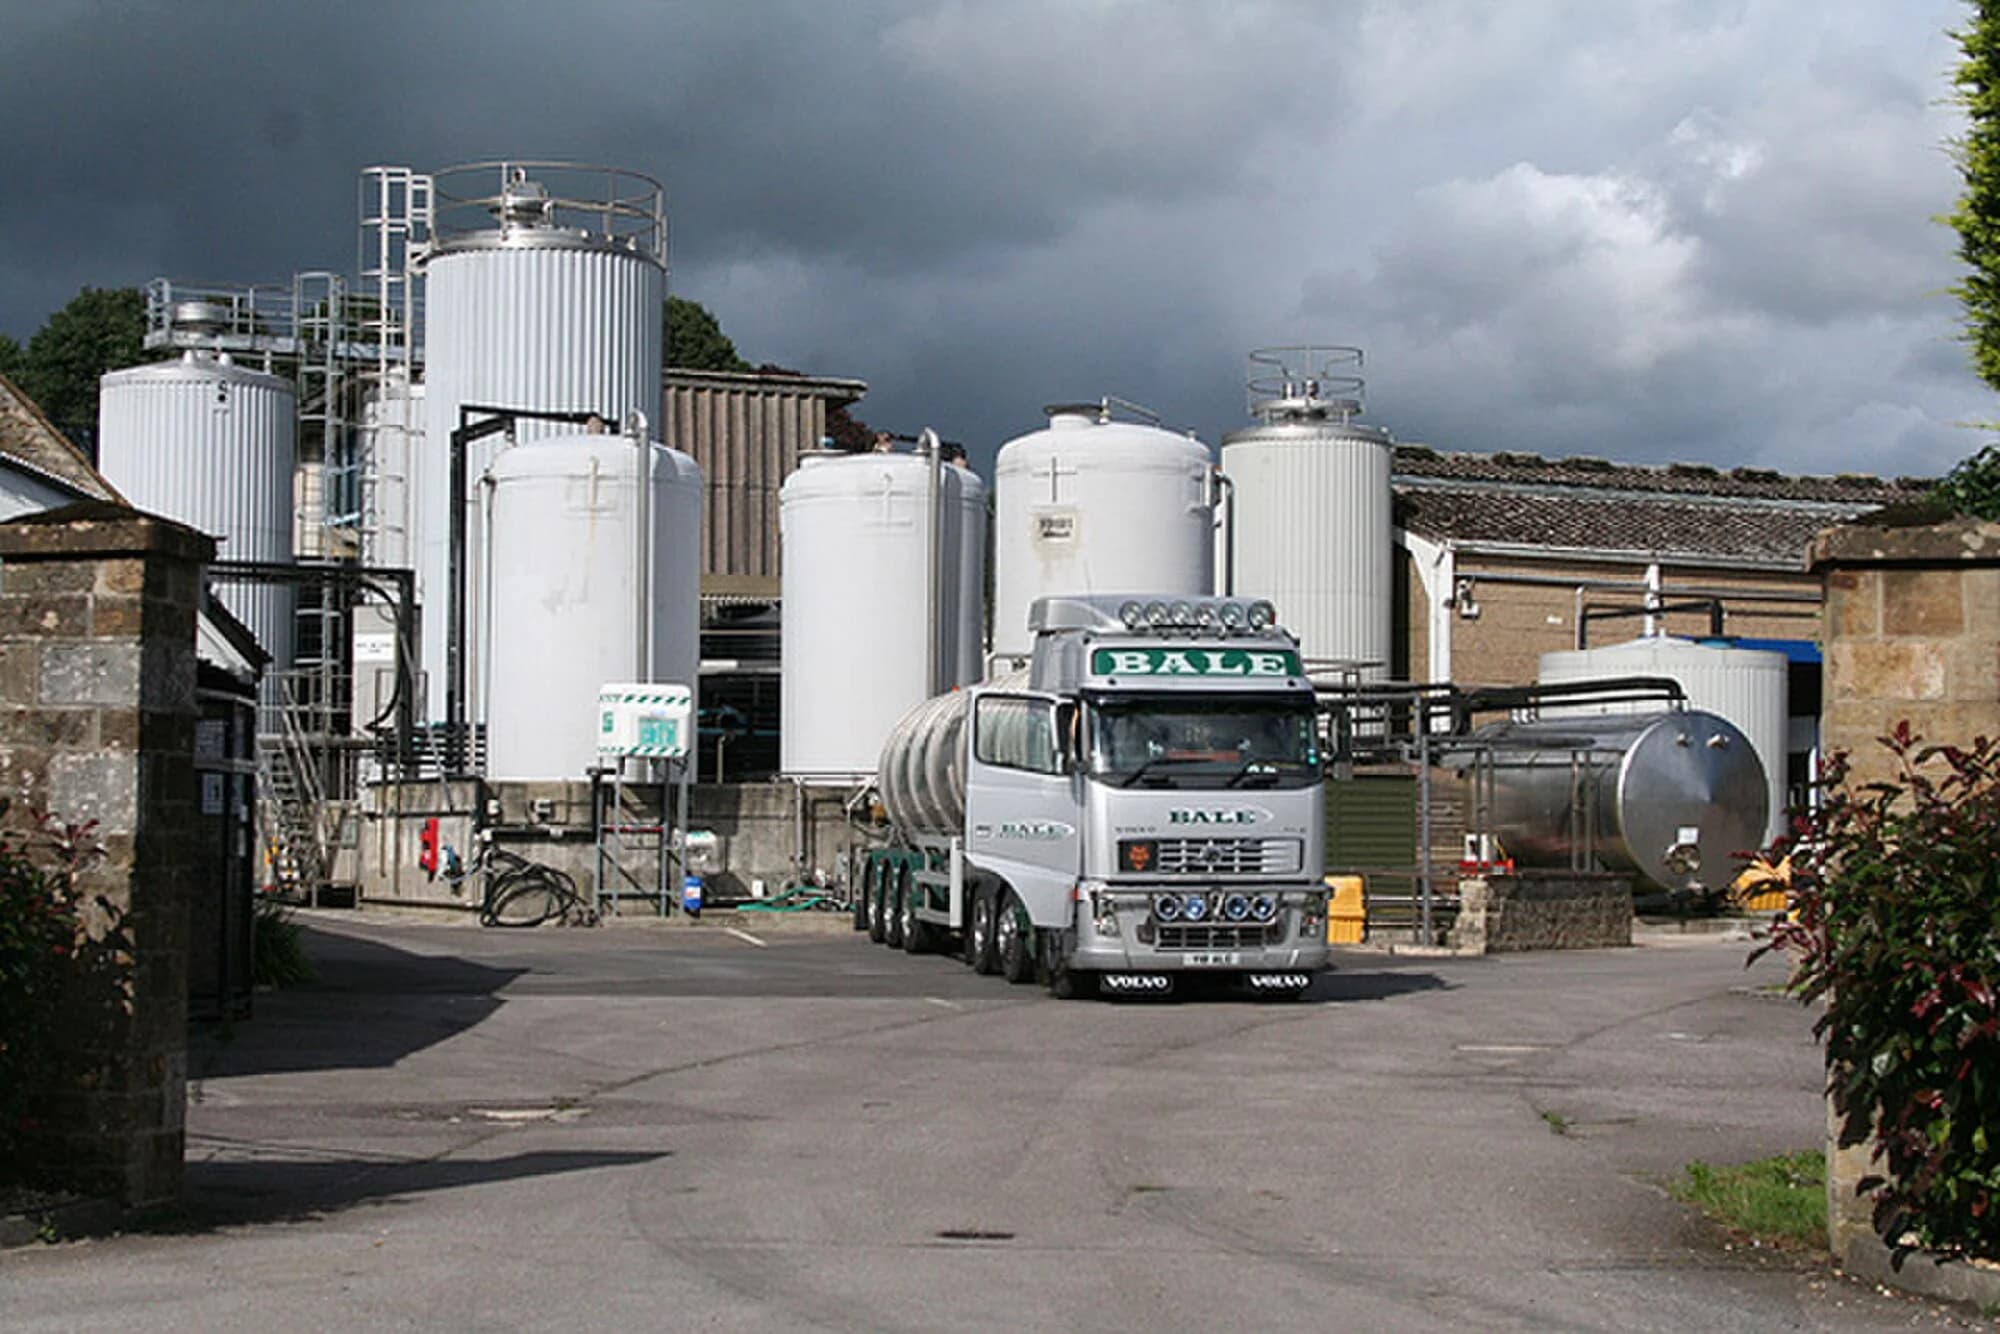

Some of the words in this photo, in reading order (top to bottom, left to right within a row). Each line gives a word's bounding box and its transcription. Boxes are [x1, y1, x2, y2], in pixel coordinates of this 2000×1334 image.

[1108, 652, 1287, 675] BALE
[1169, 811, 1257, 824] BALE
[1106, 975, 1168, 988] VOLVO
[1251, 974, 1308, 988] VOLVO
